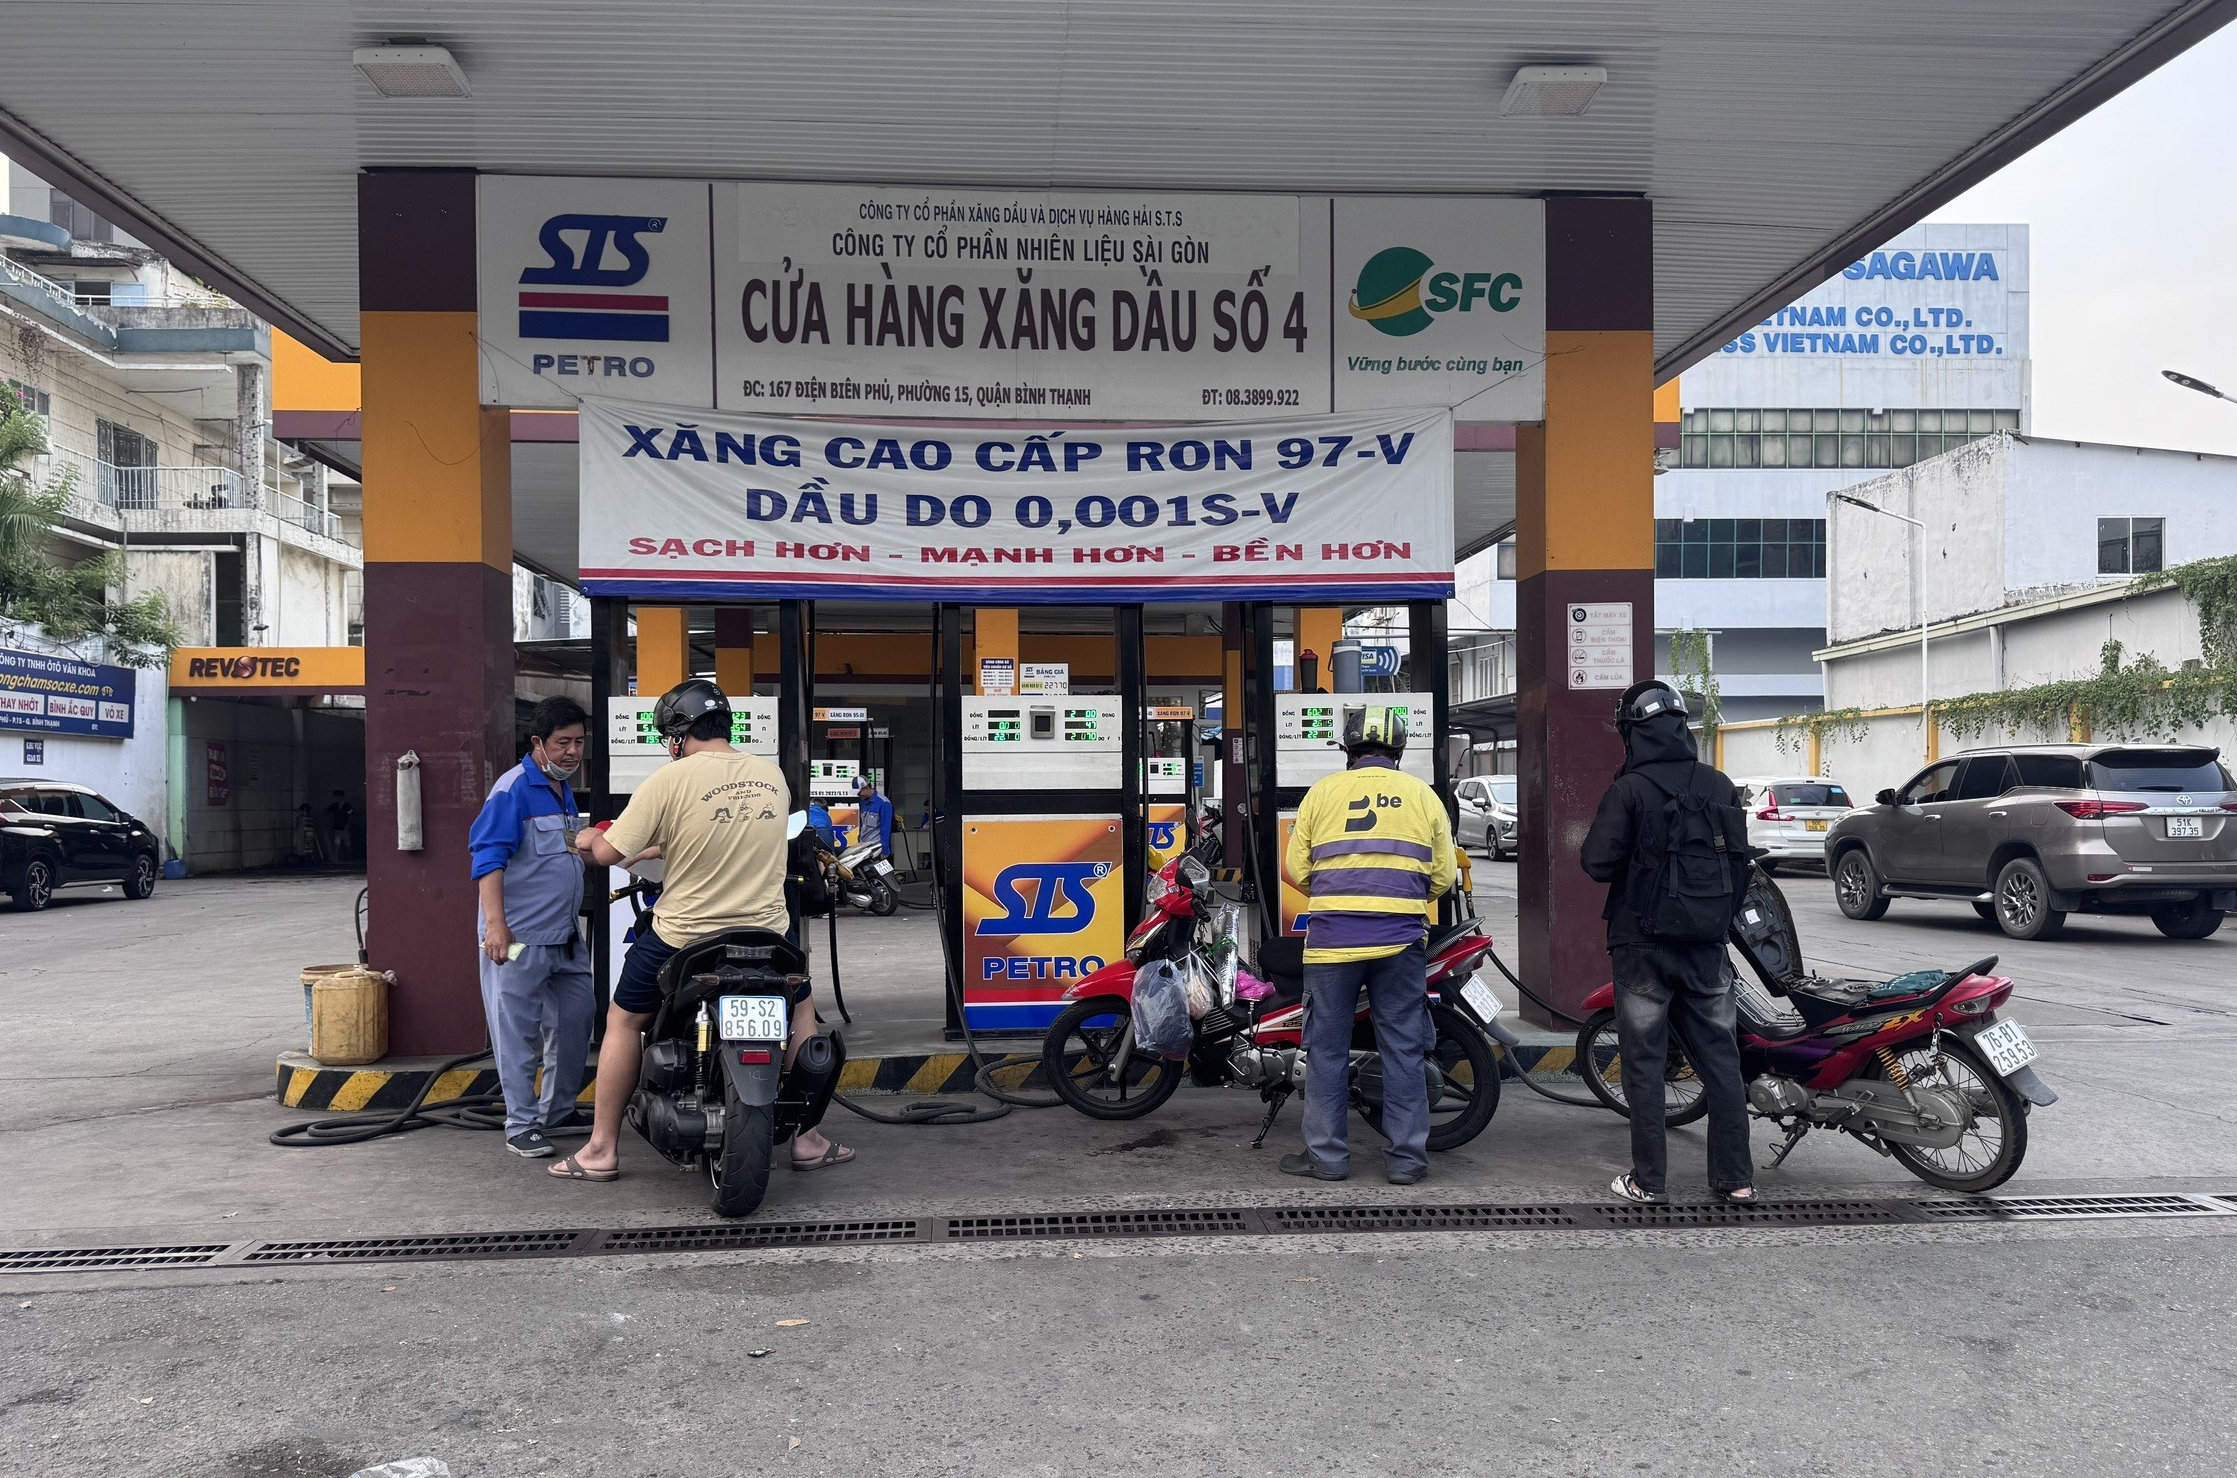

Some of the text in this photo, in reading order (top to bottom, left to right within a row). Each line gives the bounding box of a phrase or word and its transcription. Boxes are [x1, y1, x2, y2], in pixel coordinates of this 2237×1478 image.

[860, 197, 1182, 228] CÔNG TY CỔ PHẦN XĂNG DẦU VÀ DỊCH VỤ HÀNG HẢI S.T.S
[518, 214, 668, 286] STS
[833, 225, 1209, 266] CÔNG TY CỔ PHẦN NHIÊN LIỆU SÀI GÒN
[1842, 252, 1999, 280] SAGAWA
[742, 256, 1307, 352] CỬA HÀNG XĂNG DẦU SỐ 4
[1424, 272, 1522, 312] SFC
[1758, 306, 1846, 326] TNAM
[1714, 332, 1756, 353] SS
[1763, 332, 1879, 354] VIETNAM
[533, 354, 655, 378] PETRO
[1348, 356, 1523, 375] Vững bước cùng bạn
[743, 376, 1299, 409] ĐC: 167 ĐIỆN BIÊN PHỦ, PHƯỜNG 15, QUẬN BÌNH THẠNH ĐT: 08.3899.922
[622, 422, 1415, 472] XĂNG CAO CẤP RON 97-V
[746, 477, 1300, 535] DẦU DO 0,001S-V
[628, 536, 754, 560] SẠCH
[776, 541, 870, 562] HƠN
[921, 546, 1054, 566] MẠNH
[1073, 544, 1165, 563] HƠN
[1213, 537, 1303, 562] BỀN
[1322, 539, 1412, 561] HƠN
[17, 658, 26, 668] TY
[27, 659, 46, 670] TNHH
[78, 668, 96, 678] KHOA
[189, 656, 300, 678] REVOTEC
[0, 696, 16, 710] HAY
[50, 700, 66, 714] BÌNH
[80, 706, 94, 717] QUY
[116, 710, 124, 720] XE
[701, 781, 778, 802] WOODSTOCK
[1376, 793, 1402, 808] be
[2172, 827, 2199, 836] 397.35
[2177, 818, 2192, 826] 51K
[1148, 822, 1180, 850] TS
[975, 862, 1112, 935] STS
[983, 955, 1106, 980] PETRO
[730, 1000, 775, 1017] 59-S2
[725, 1020, 782, 1037] 856.09
[1982, 1023, 2018, 1051] 76-B1
[1993, 1040, 2035, 1072] 259.53
